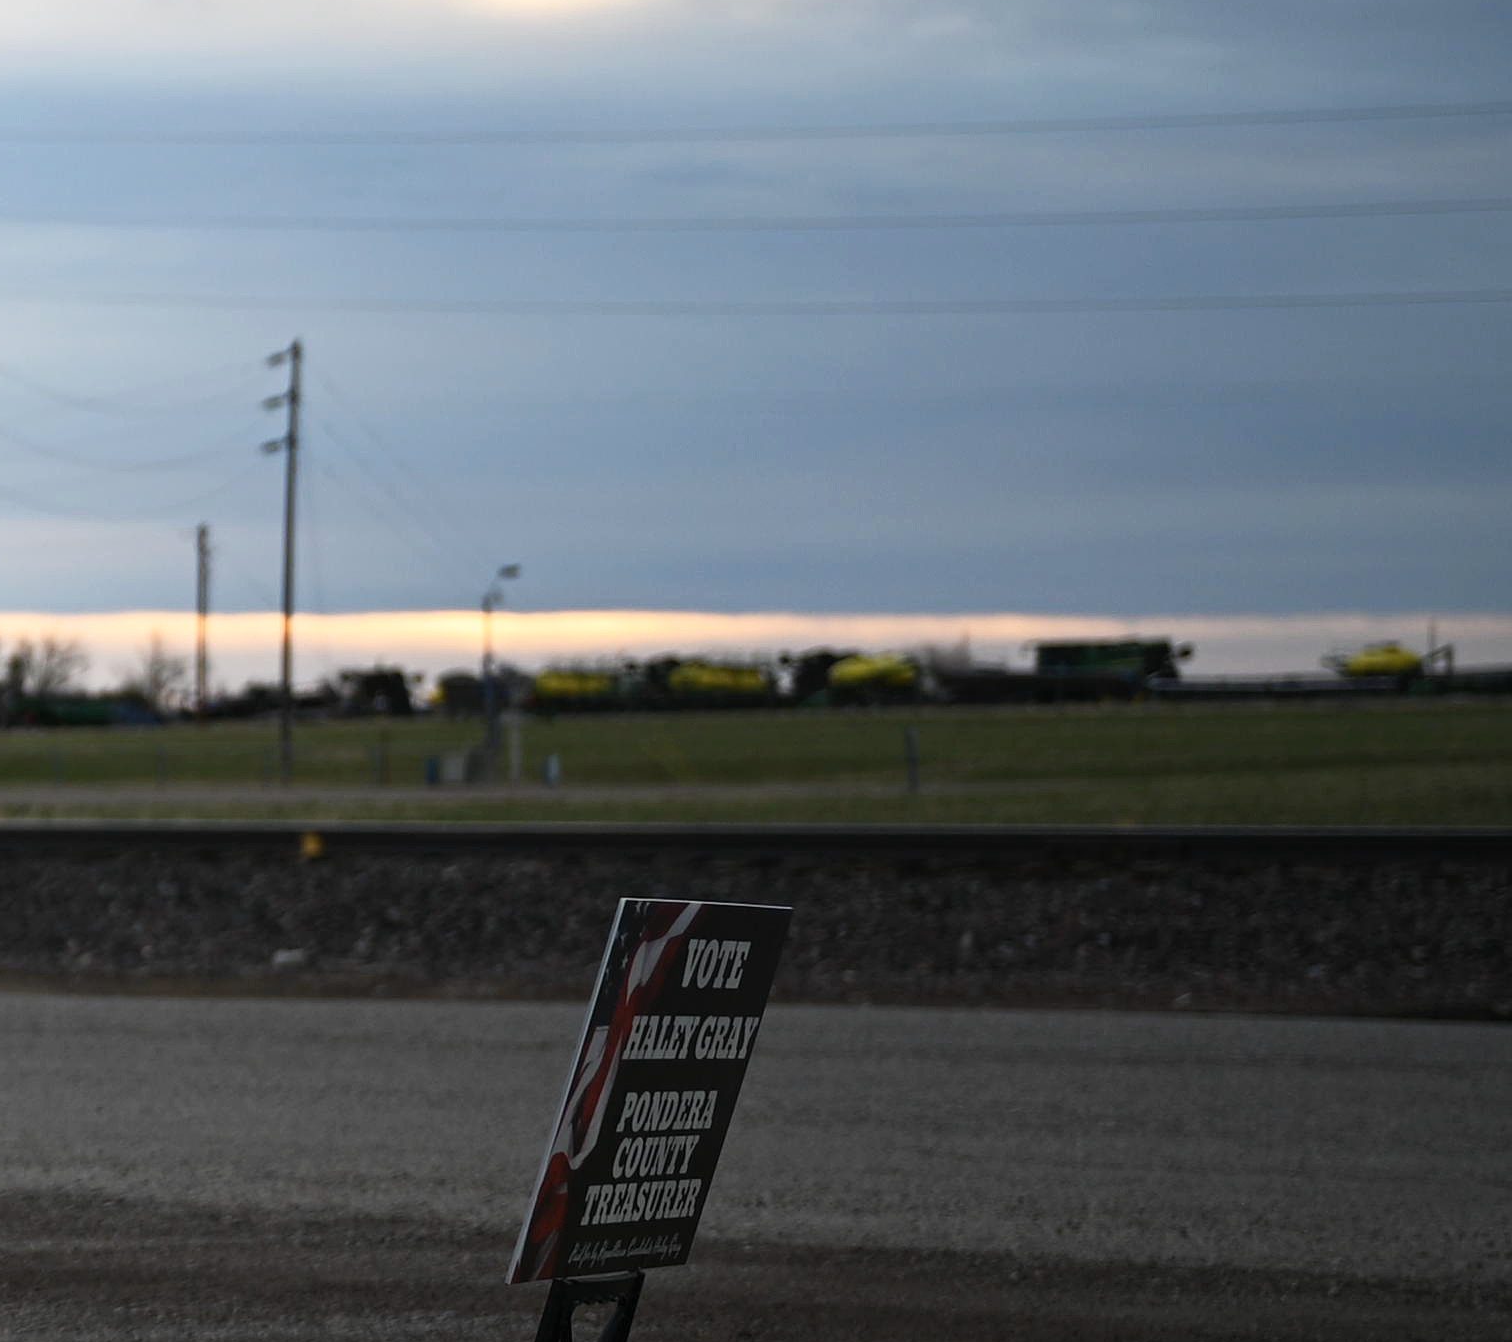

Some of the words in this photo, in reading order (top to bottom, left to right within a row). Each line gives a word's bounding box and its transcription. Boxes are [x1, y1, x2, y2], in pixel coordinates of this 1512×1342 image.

[681, 939, 751, 990] VOTE
[622, 1015, 701, 1059] HALEY
[695, 1015, 760, 1059] GRAY
[616, 1090, 718, 1133] PONDERA
[612, 1135, 700, 1179] COUNTY
[580, 1179, 702, 1226] TREASURER
